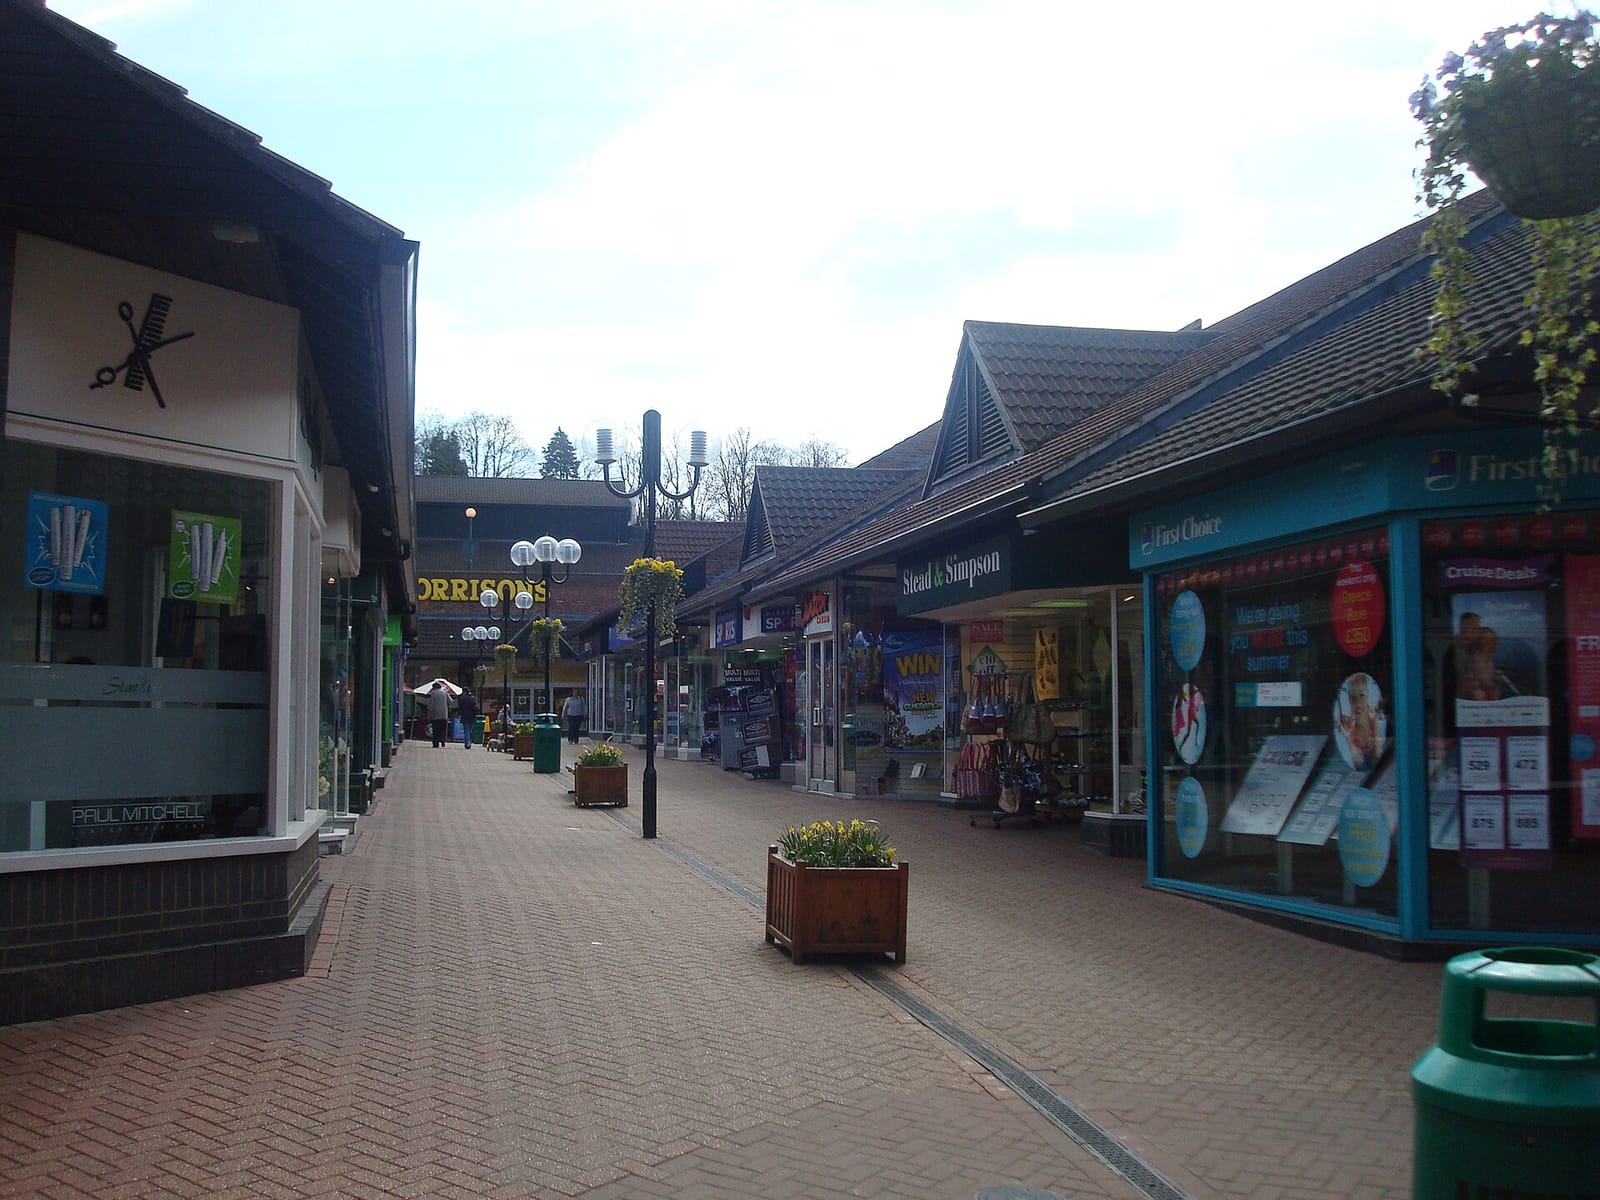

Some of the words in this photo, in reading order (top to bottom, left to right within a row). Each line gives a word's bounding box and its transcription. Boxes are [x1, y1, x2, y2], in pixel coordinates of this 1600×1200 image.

[1470, 454, 1540, 482] First
[1156, 523, 1180, 547] First
[1182, 513, 1223, 541] Choice
[903, 562, 932, 595] Stead
[934, 560, 943, 588] &
[945, 551, 1000, 588] Simpson
[1446, 565, 1495, 579] Cruise
[1496, 566, 1538, 580] Deals
[1287, 626, 1309, 647] this
[896, 653, 942, 677] WIN
[1247, 656, 1290, 672] summer
[72, 808, 121, 824] PAUL
[122, 805, 205, 821] MITCHELL
